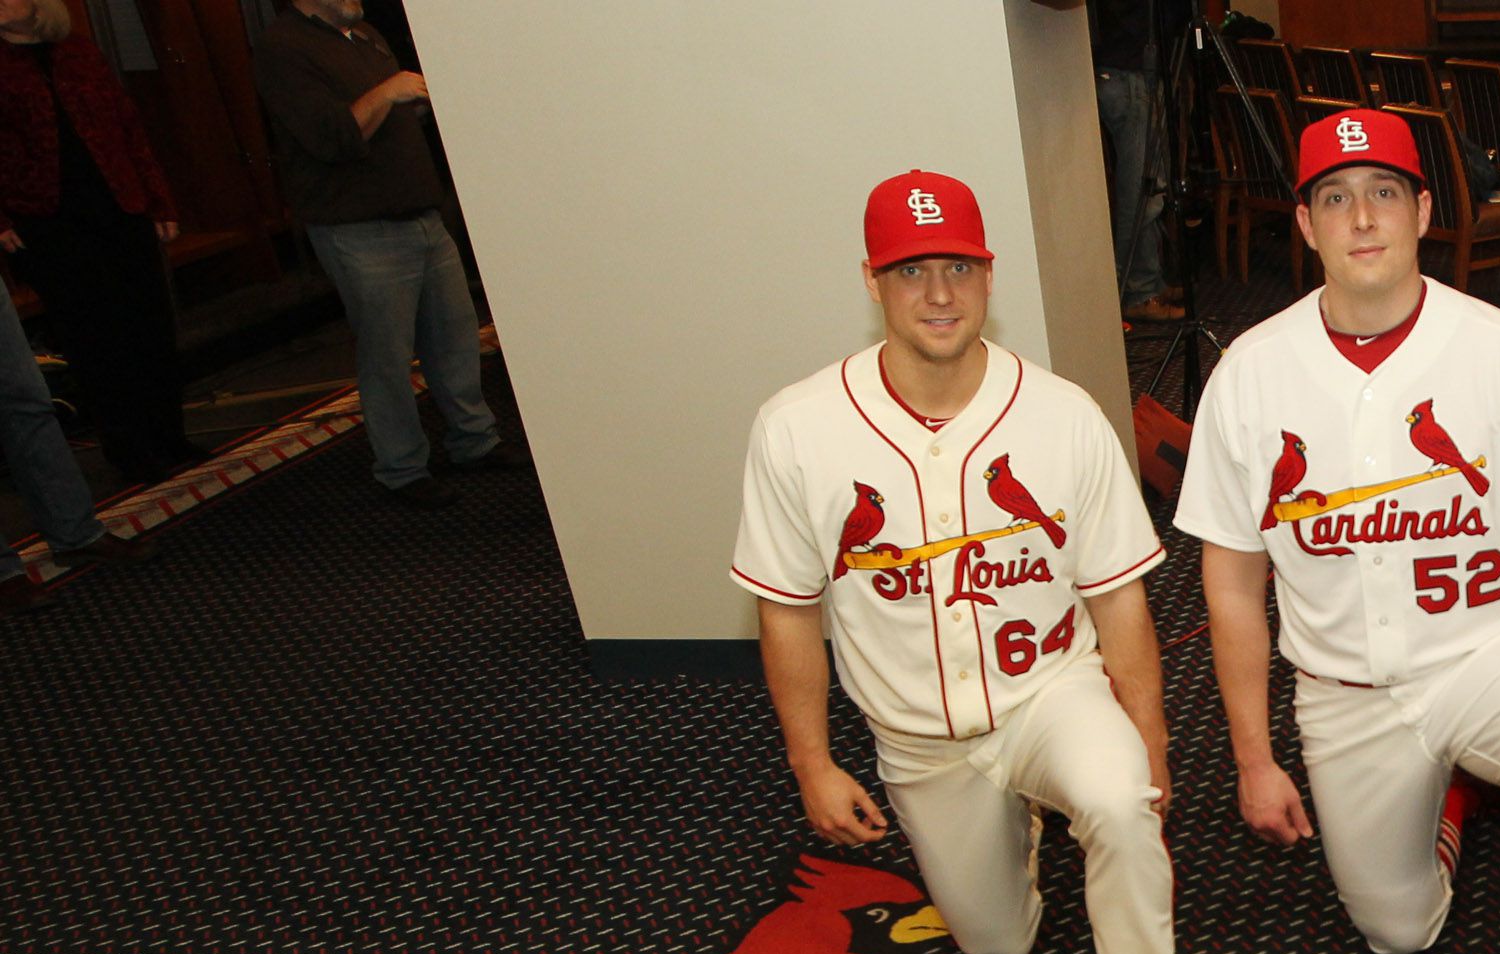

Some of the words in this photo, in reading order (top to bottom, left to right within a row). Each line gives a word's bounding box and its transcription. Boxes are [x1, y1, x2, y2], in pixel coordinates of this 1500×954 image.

[1292, 490, 1490, 556] Cardinals
[945, 540, 1054, 607] Louis
[995, 604, 1075, 676] 64
